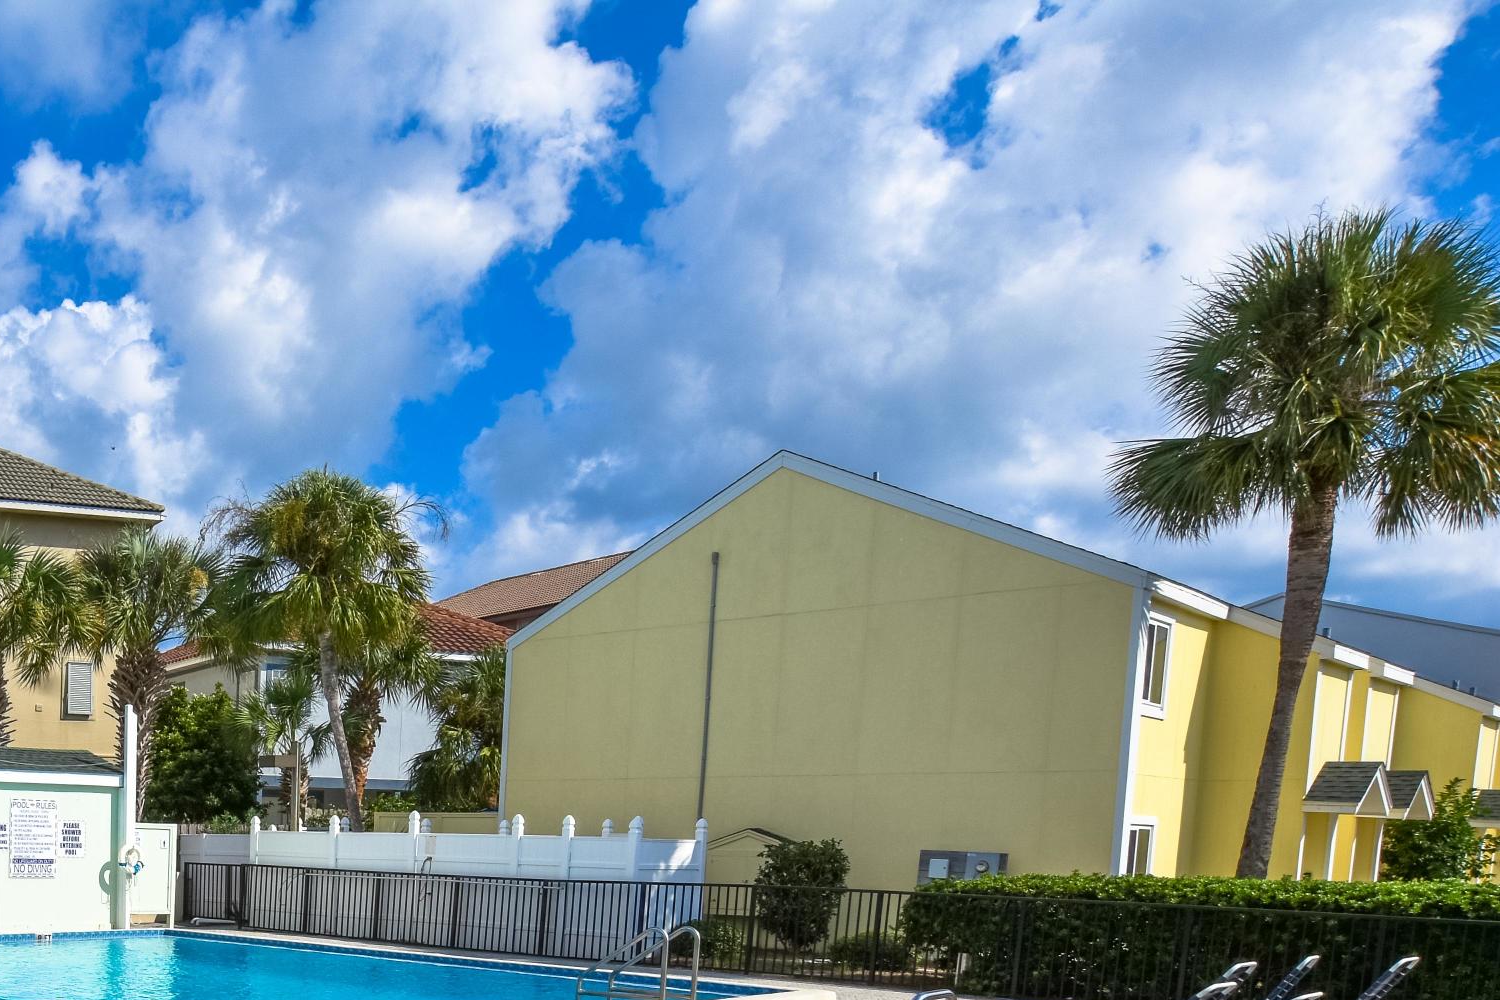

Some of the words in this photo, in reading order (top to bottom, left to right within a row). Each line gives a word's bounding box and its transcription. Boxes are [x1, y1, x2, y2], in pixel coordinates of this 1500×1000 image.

[35, 802, 56, 810] RULES
[13, 864, 26, 873] NO
[27, 865, 53, 874] DIVING
